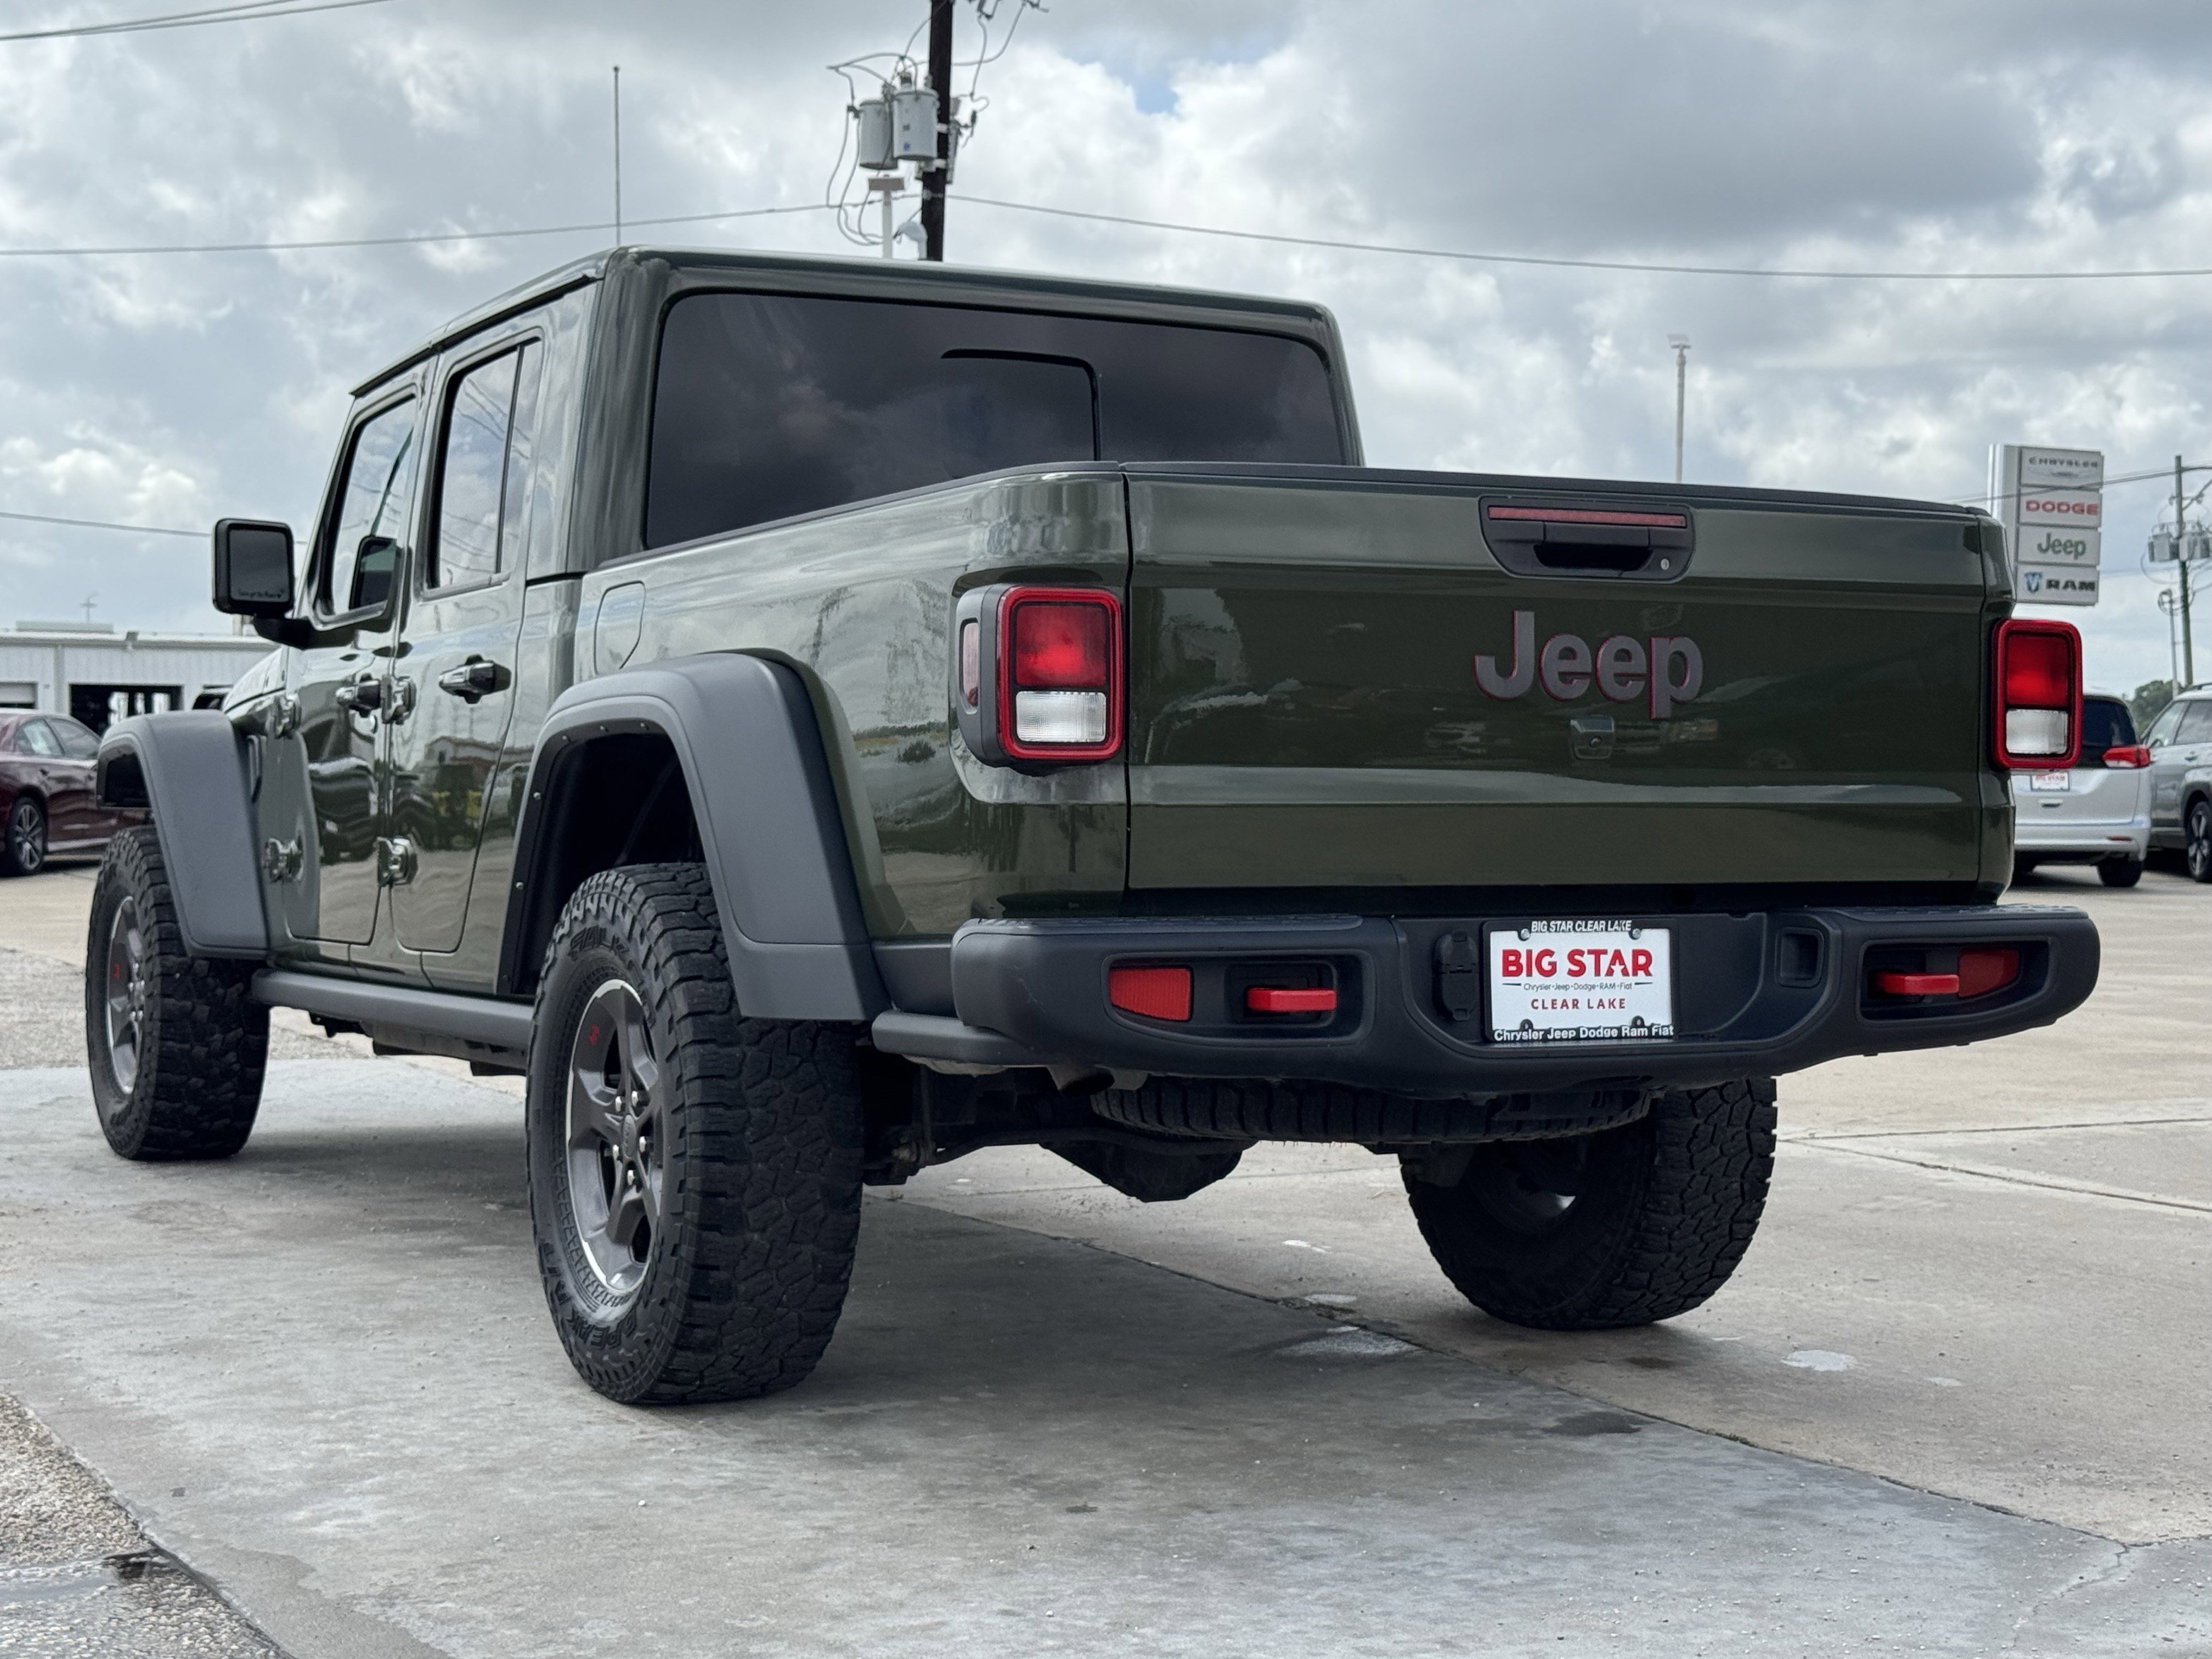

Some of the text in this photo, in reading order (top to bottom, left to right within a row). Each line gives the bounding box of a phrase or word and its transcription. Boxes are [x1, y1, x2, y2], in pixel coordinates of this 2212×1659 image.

[2025, 500, 2098, 515] DODGE
[2037, 532, 2086, 560] Jeep
[2046, 579, 2095, 591] RAM
[1473, 609, 1703, 719] Jeep
[1531, 920, 1632, 932] BIG STAR CLEAR LAKE
[1502, 949, 1653, 977] BIG STAR
[1531, 998, 1626, 1010] CLEAR LAKE
[1494, 1024, 1674, 1041] Chrysler Jeep Dodge Ram Fiat
